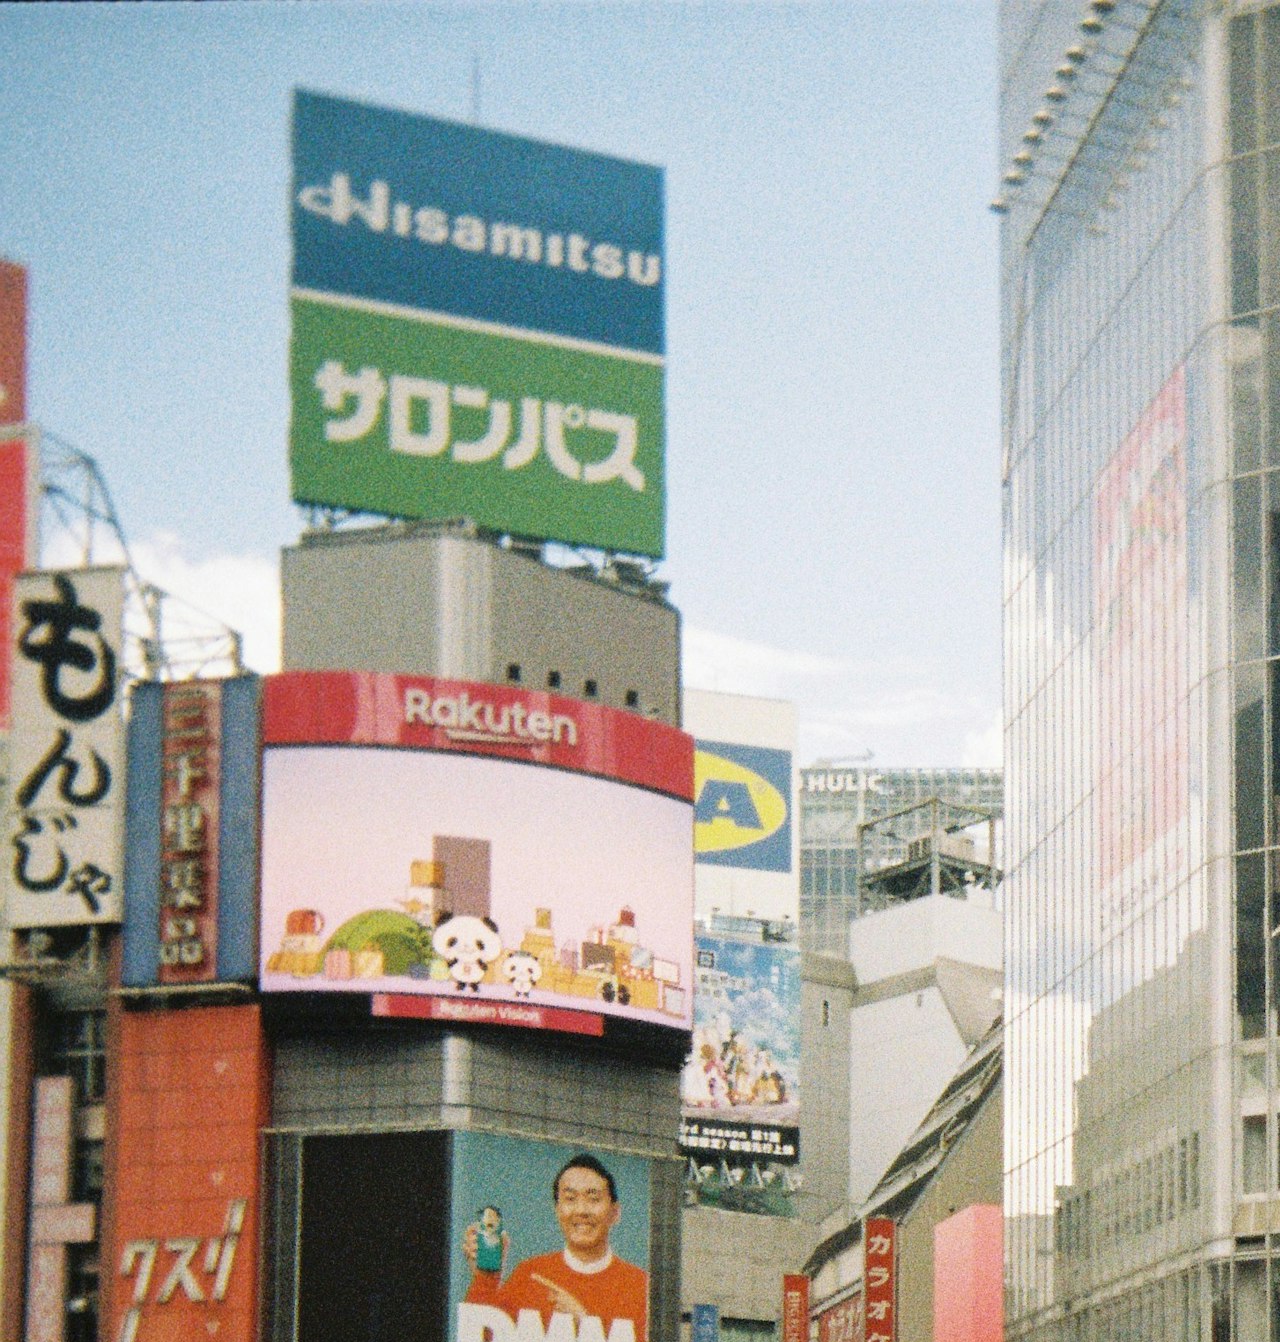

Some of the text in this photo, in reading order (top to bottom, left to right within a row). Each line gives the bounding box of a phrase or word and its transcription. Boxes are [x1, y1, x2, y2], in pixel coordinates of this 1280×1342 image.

[298, 171, 661, 286] Hisamitsu
[314, 361, 645, 492] サロンパス
[15, 572, 117, 914] もんじゃ
[404, 689, 577, 746] Rakuten
[809, 774, 885, 794] HULIC
[439, 1002, 496, 1018] Rakuten
